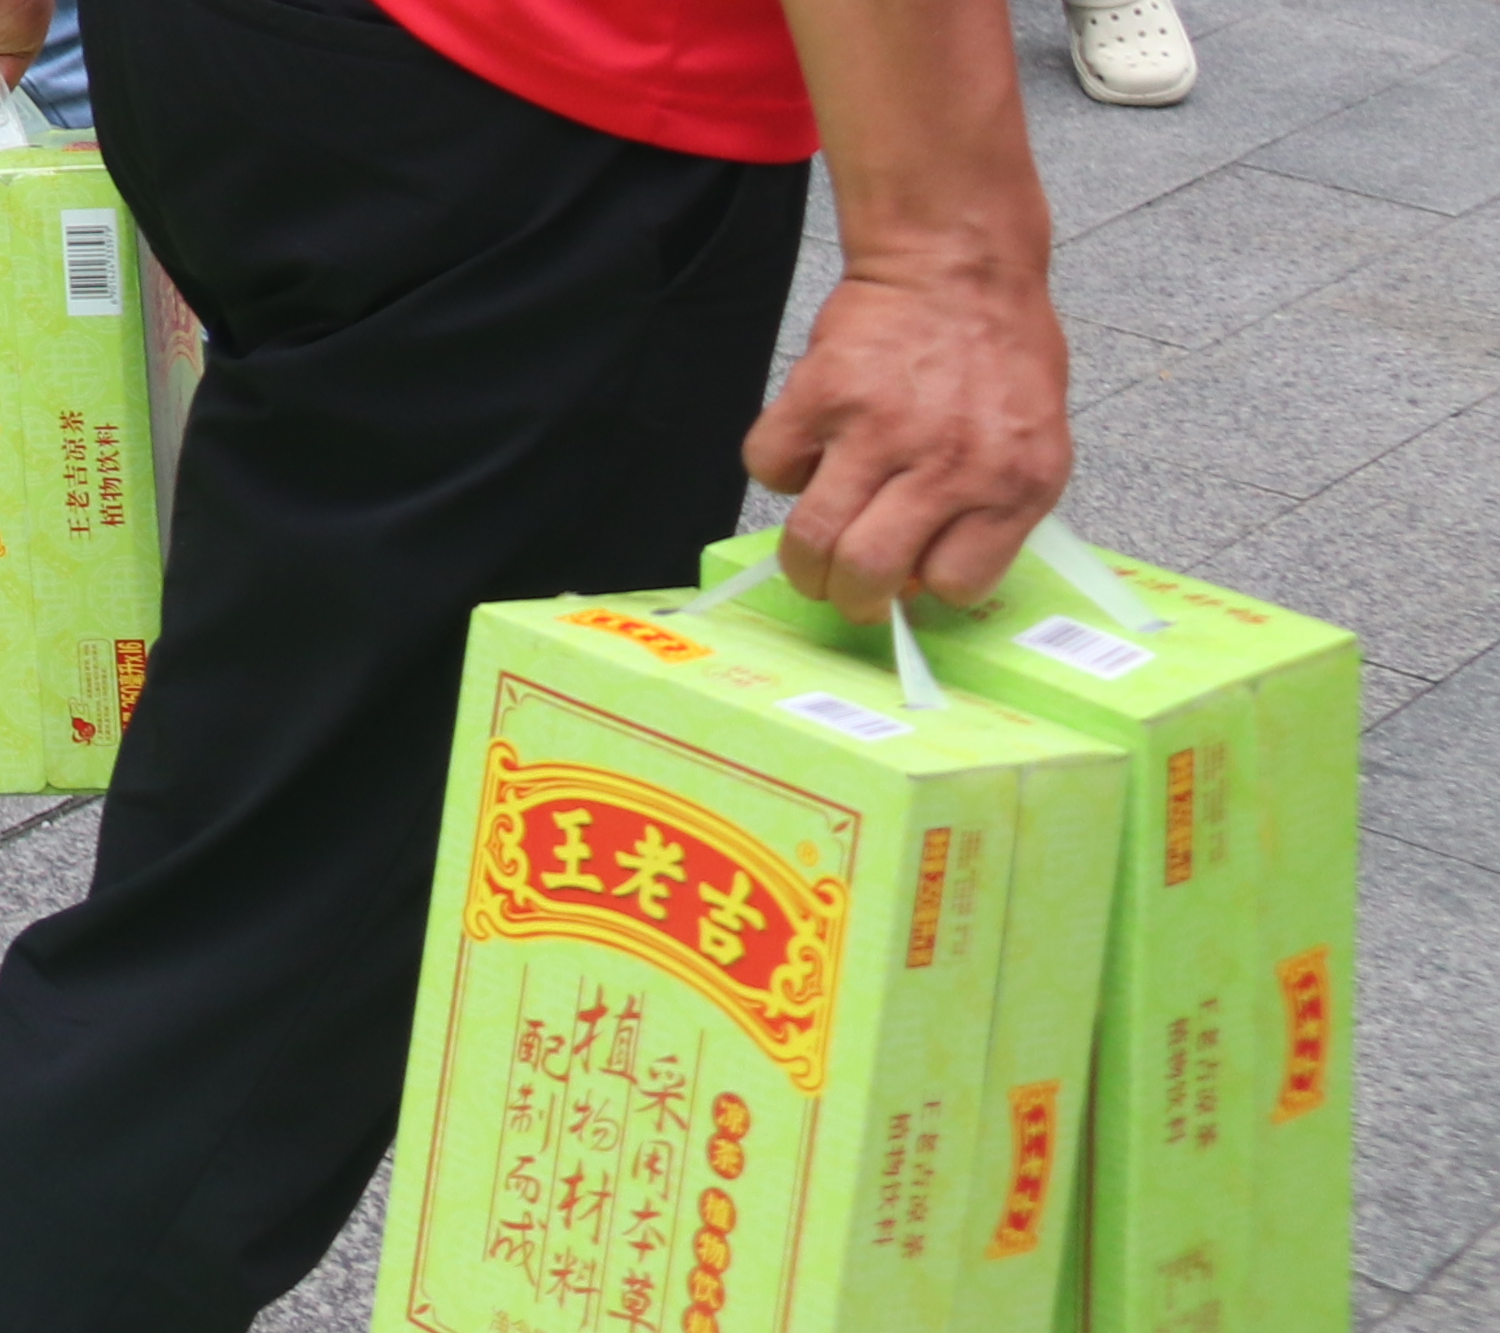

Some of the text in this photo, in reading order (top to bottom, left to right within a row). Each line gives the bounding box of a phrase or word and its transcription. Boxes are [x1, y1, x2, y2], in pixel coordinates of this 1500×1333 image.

[57, 409, 92, 540] 王老吉凉茶
[92, 421, 126, 528] 植物饮料
[539, 807, 767, 969] 王老吉
[488, 1018, 567, 1287] 配制而成
[548, 979, 642, 1331] 植物材料
[606, 1056, 689, 1331] 采用本草
